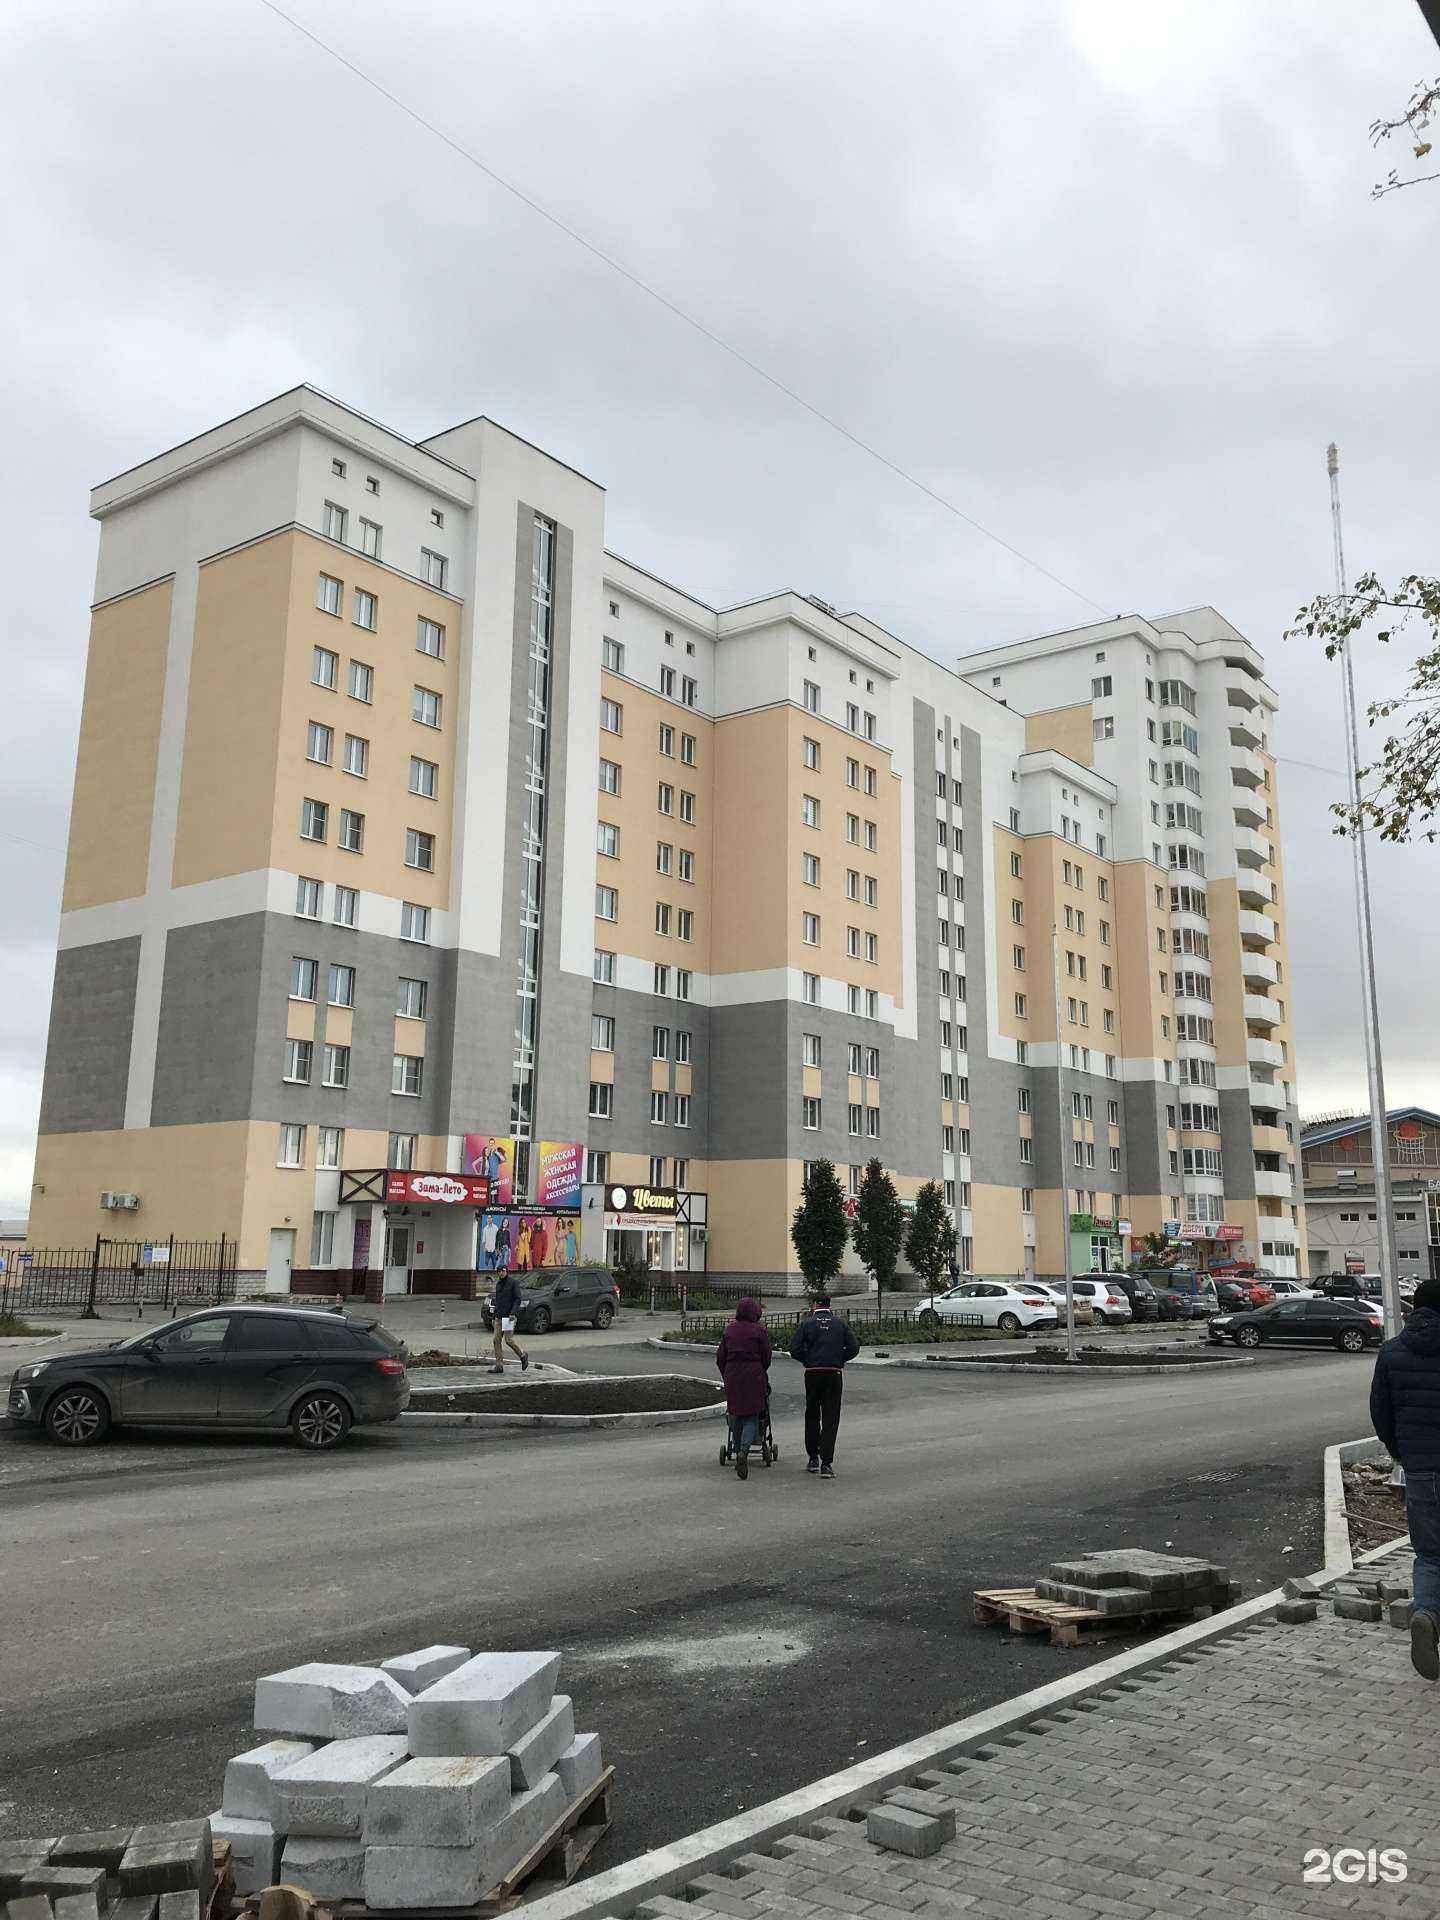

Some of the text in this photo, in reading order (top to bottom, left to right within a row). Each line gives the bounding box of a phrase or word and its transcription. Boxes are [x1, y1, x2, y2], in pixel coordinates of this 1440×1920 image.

[543, 1148, 576, 1166] МУЖСКАЯ
[545, 1161, 577, 1178] ЖЕНСКАЯ
[546, 1173, 577, 1189] ОДЕЖДА
[632, 1188, 674, 1210] Цветы
[1182, 1223, 1204, 1234] ДВЕРИ
